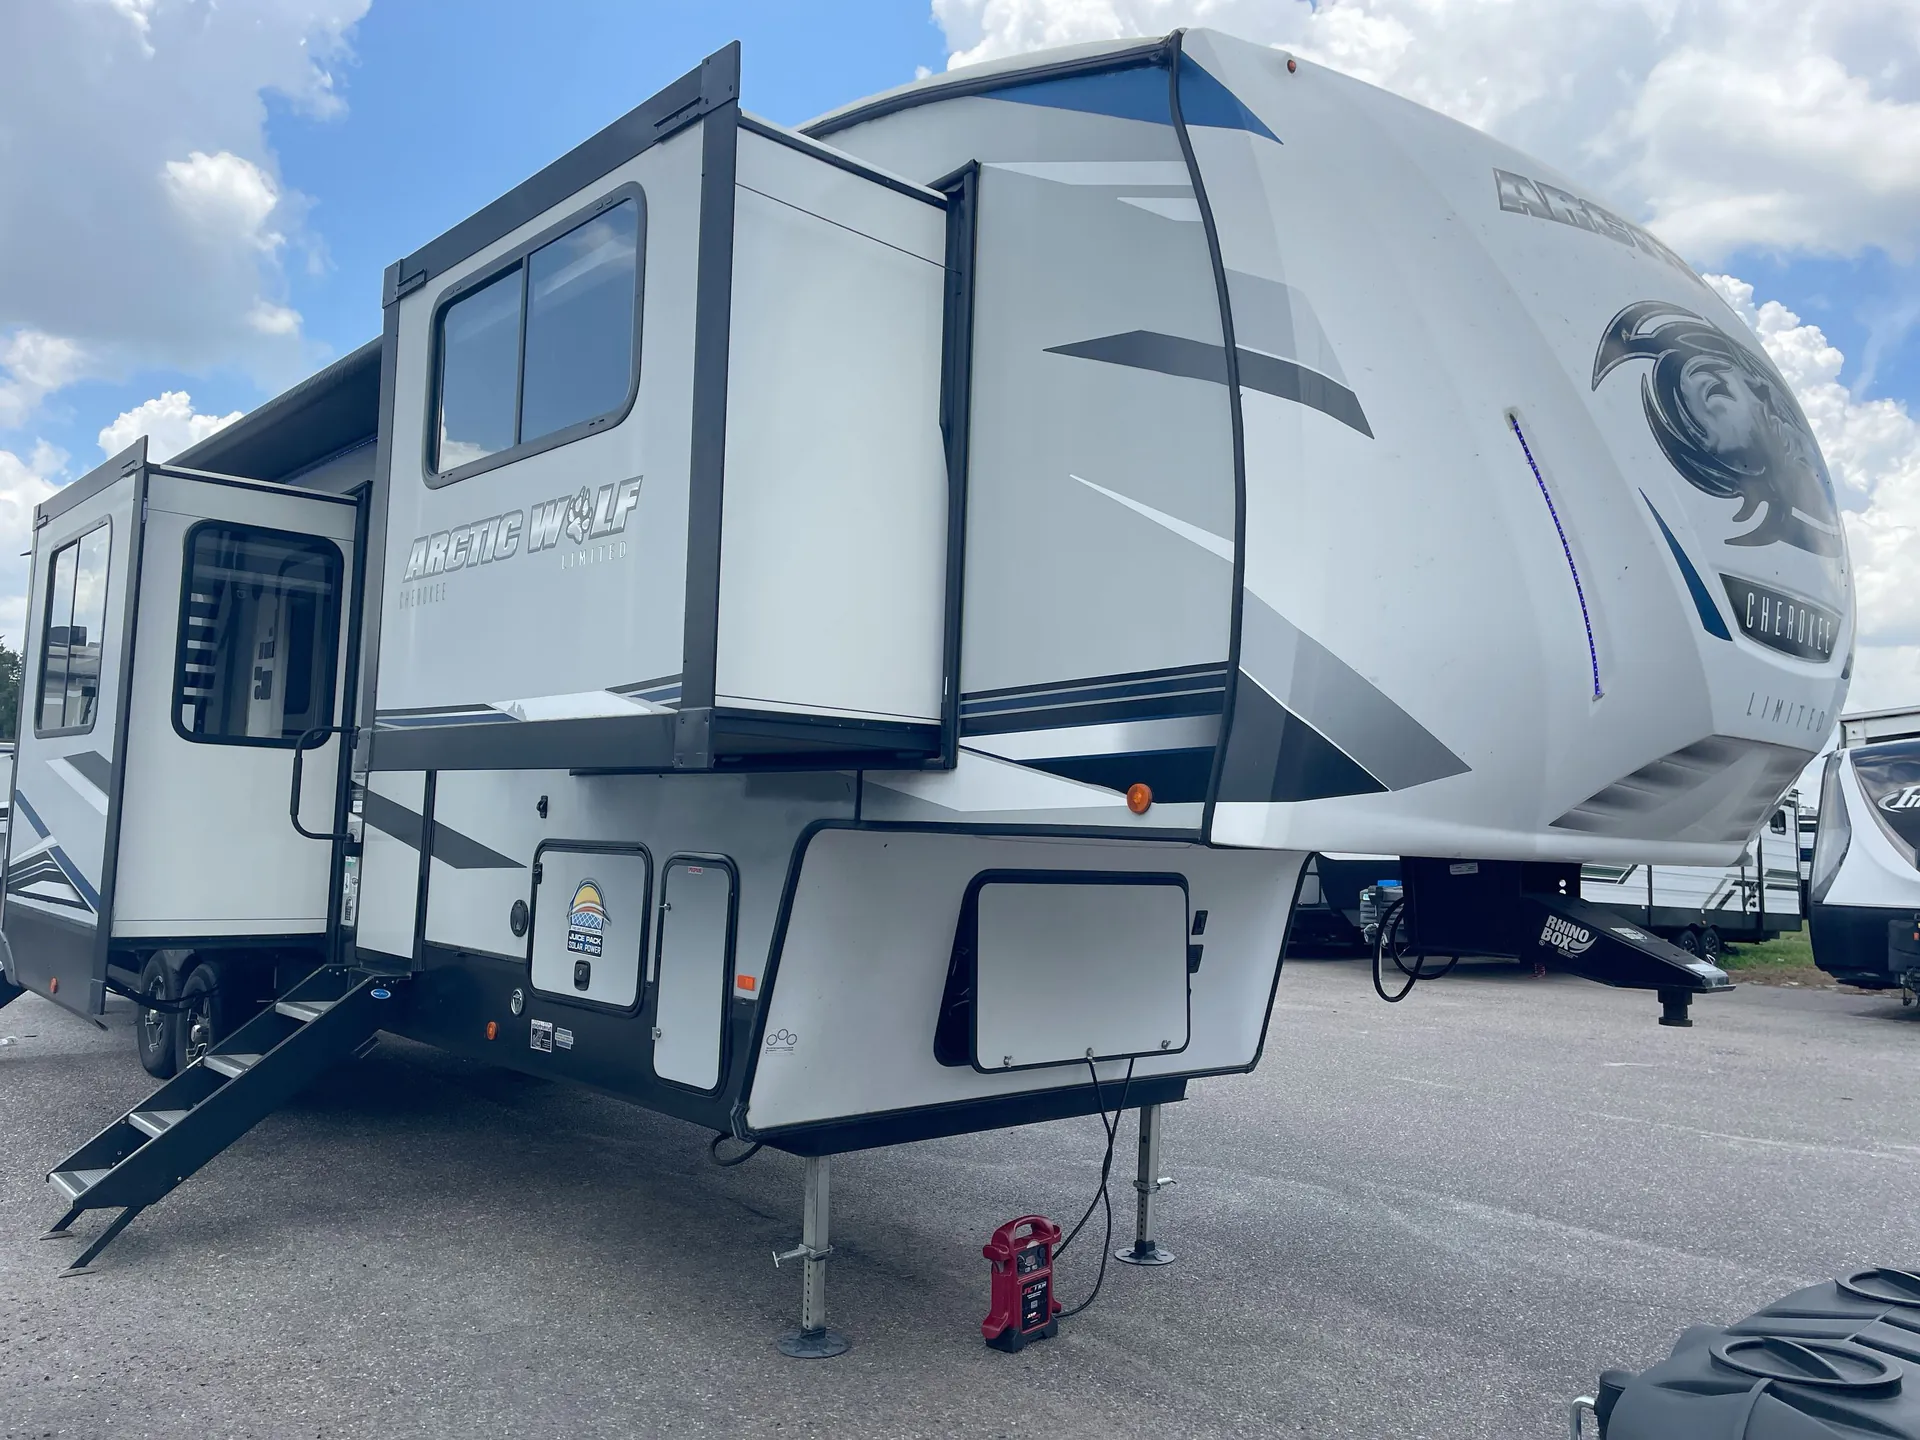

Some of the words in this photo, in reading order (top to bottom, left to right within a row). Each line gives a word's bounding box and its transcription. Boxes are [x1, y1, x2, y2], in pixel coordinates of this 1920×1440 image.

[402, 509, 523, 583] ARCTIC
[561, 540, 627, 570] LIMITED
[399, 582, 446, 611] CHEROKEE
[1746, 592, 1831, 654] CHEROKEE
[1746, 692, 1825, 733] LIMITED
[568, 933, 585, 942] JUICE
[585, 935, 602, 946] PACK
[1540, 926, 1575, 951] BOX
[1545, 914, 1590, 943] RHINO
[568, 940, 584, 951] SOLAR
[584, 943, 602, 955] POWER
